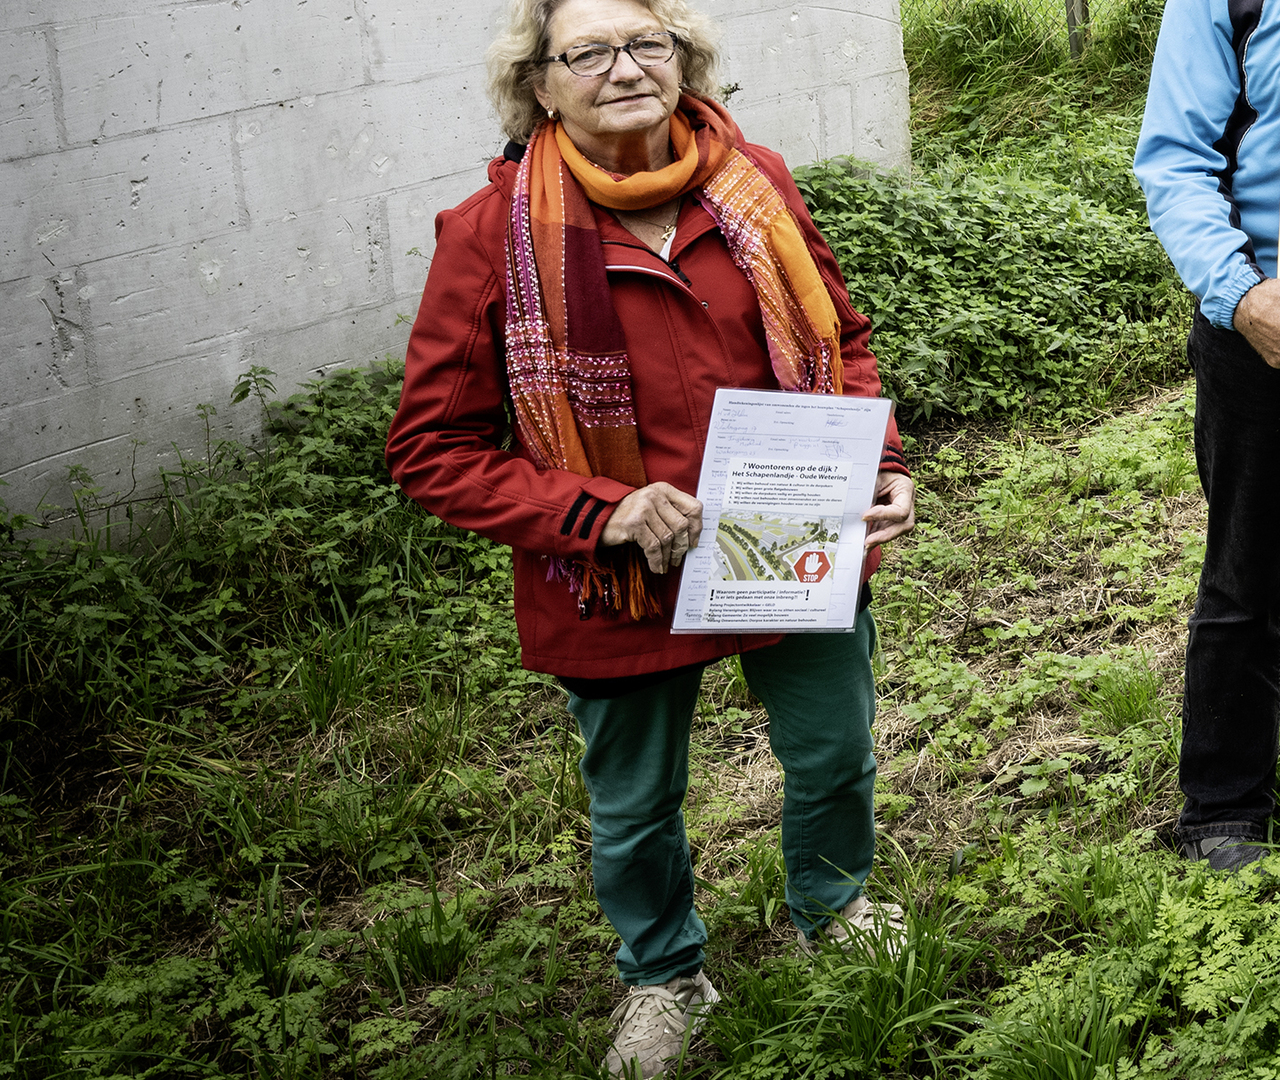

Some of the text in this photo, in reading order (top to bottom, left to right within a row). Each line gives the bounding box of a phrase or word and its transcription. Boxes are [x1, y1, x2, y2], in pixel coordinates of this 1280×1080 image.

[748, 463, 794, 471] Woontorens
[818, 465, 832, 473] dijk
[746, 471, 794, 480] Schapenlandje
[818, 473, 847, 481] Wetering
[803, 574, 818, 582] STOP
[710, 589, 714, 601] !
[805, 590, 810, 601] !
